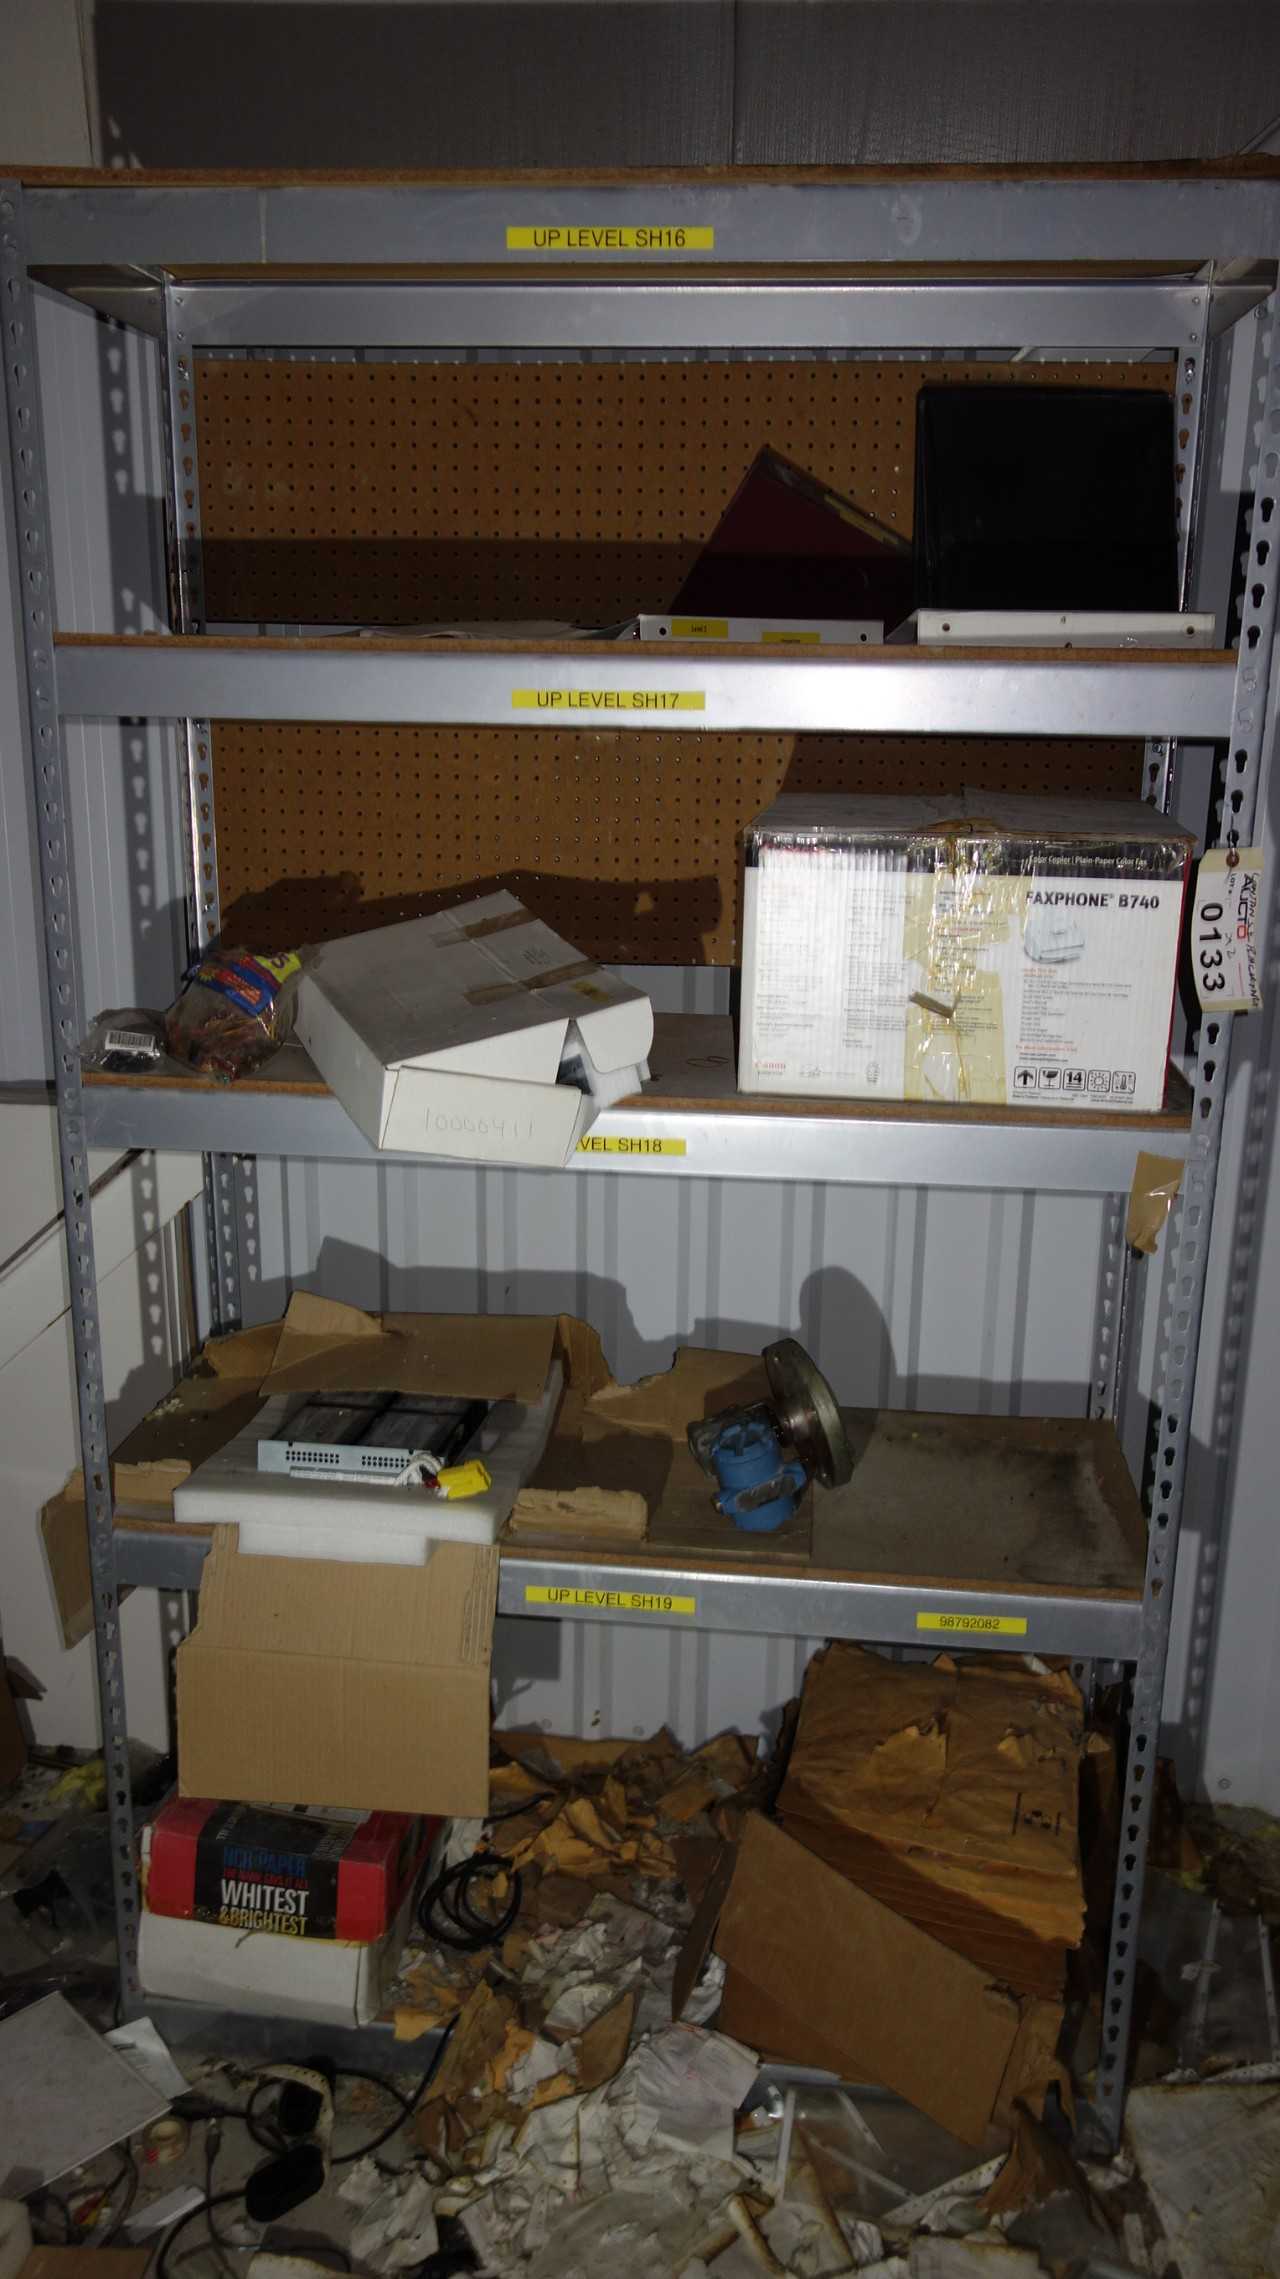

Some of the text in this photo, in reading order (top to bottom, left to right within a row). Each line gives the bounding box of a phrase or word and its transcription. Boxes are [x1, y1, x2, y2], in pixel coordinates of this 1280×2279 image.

[533, 228, 686, 248] UP LEVEL SH16
[536, 691, 680, 709] UP LEVEL SH17
[1118, 893, 1160, 910] B740
[1199, 902, 1226, 992] 0133
[580, 1136, 663, 1154] VEL SH18
[547, 1588, 673, 1610] UP LEVEL SH19
[220, 1878, 310, 1916] WHITEST
[218, 1904, 309, 1936] &BRIGHTEST
